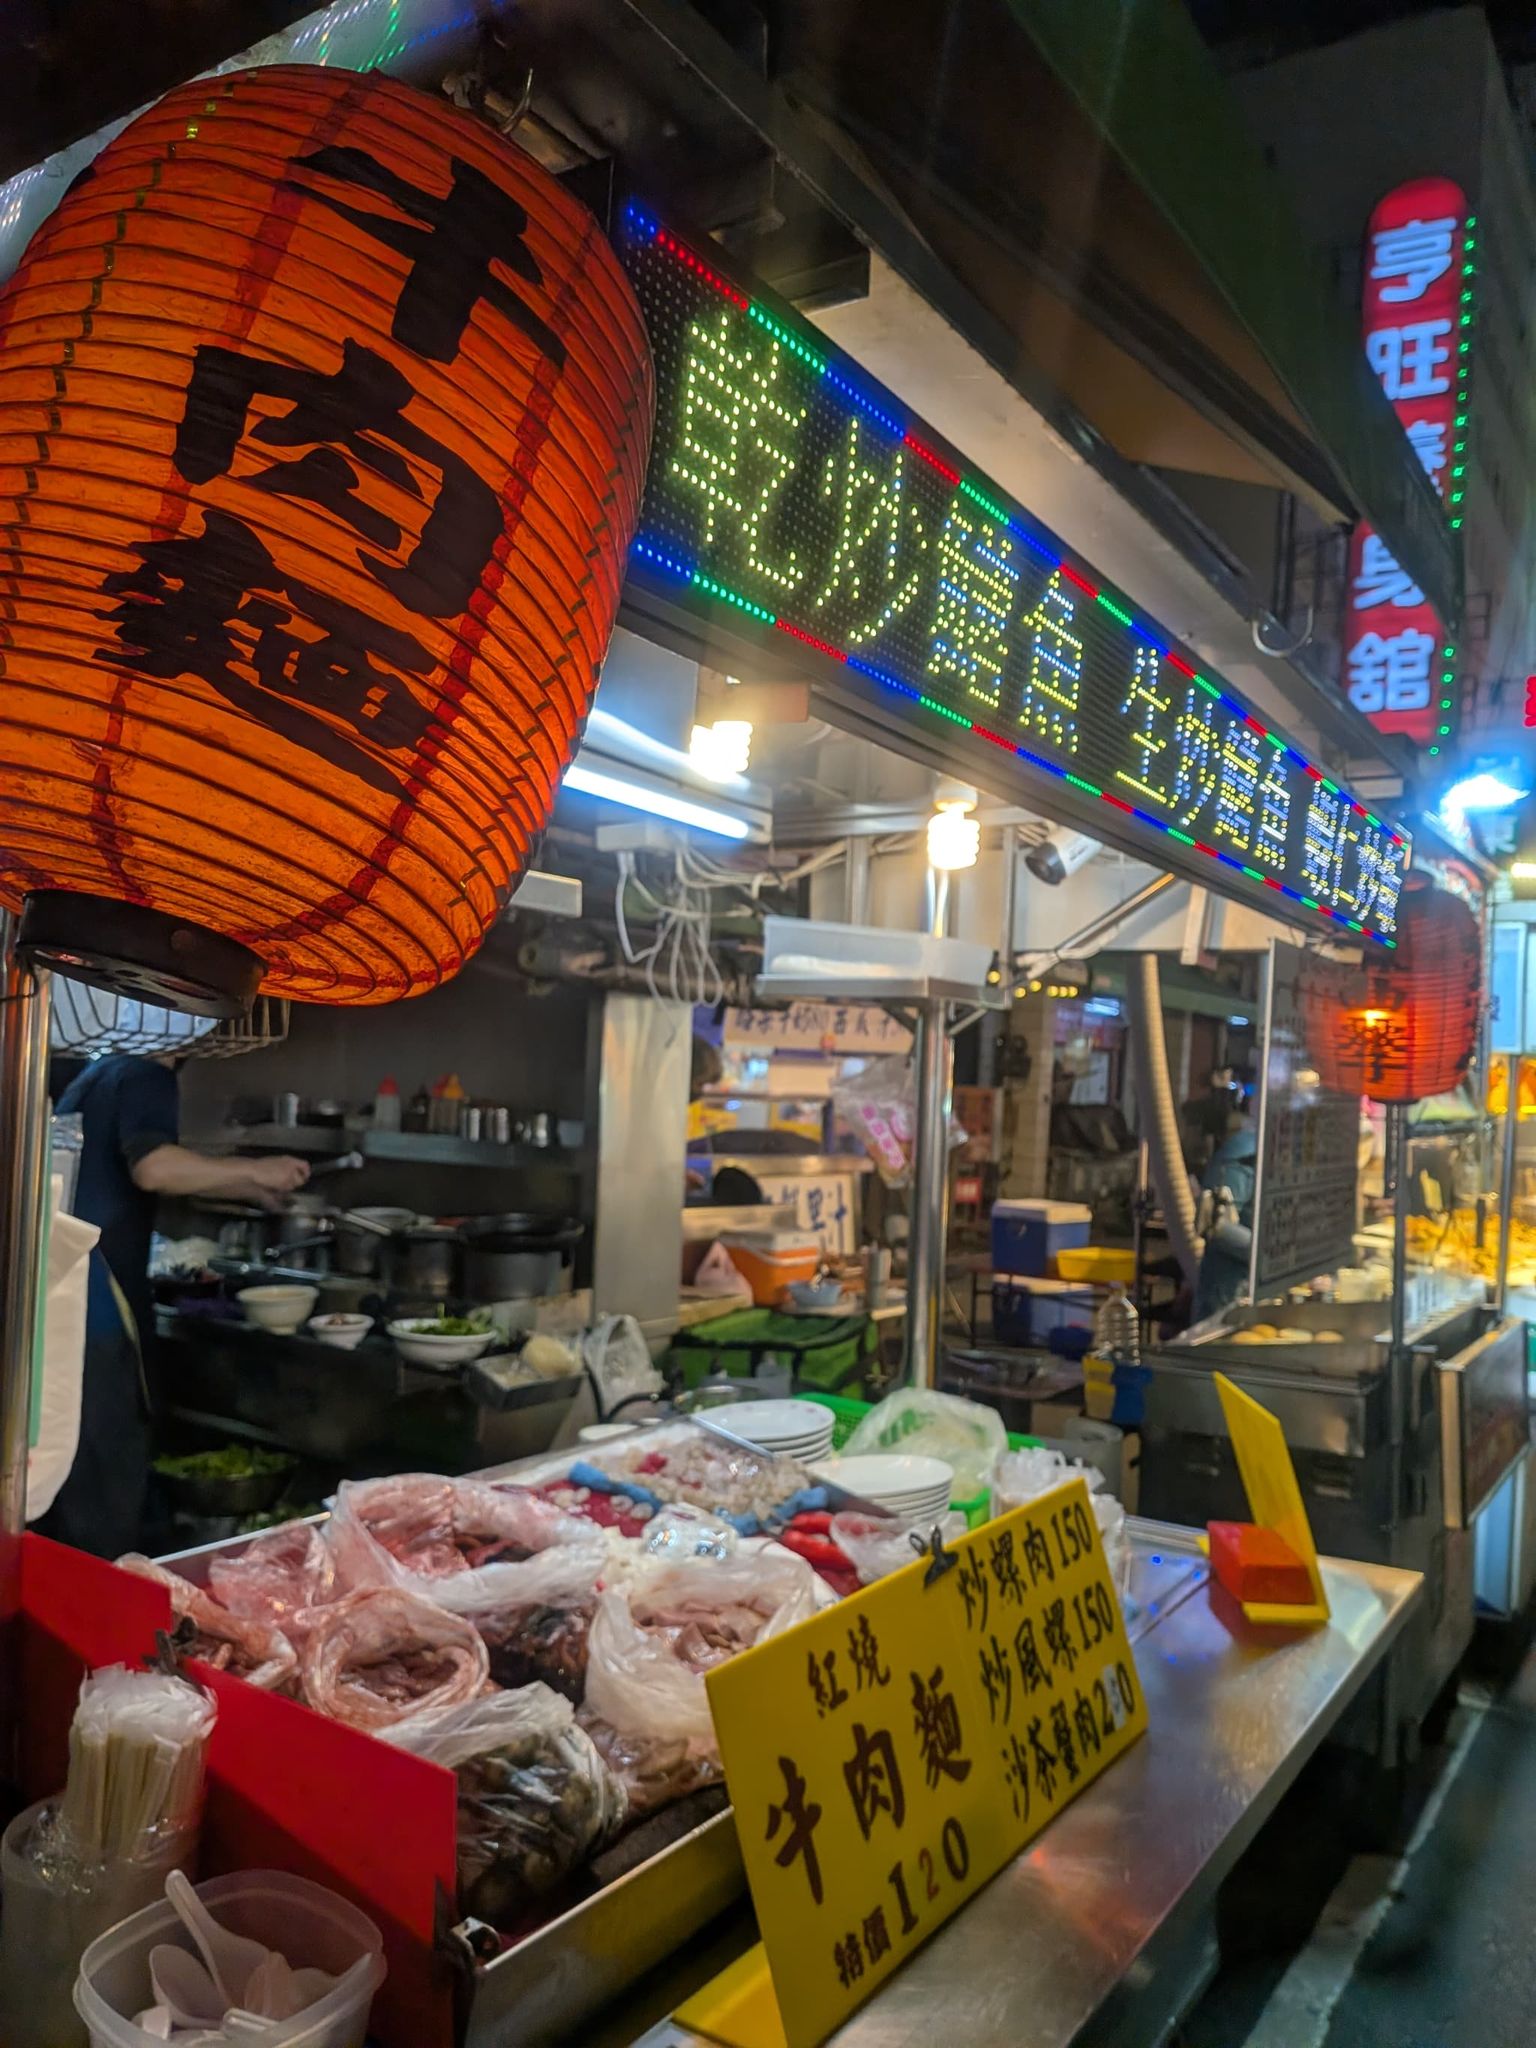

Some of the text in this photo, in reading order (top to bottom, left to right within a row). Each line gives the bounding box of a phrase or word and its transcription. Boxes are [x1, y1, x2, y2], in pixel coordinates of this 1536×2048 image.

[806, 1613, 891, 1718] 紅燒
[765, 1666, 972, 1905] 牛肉麵
